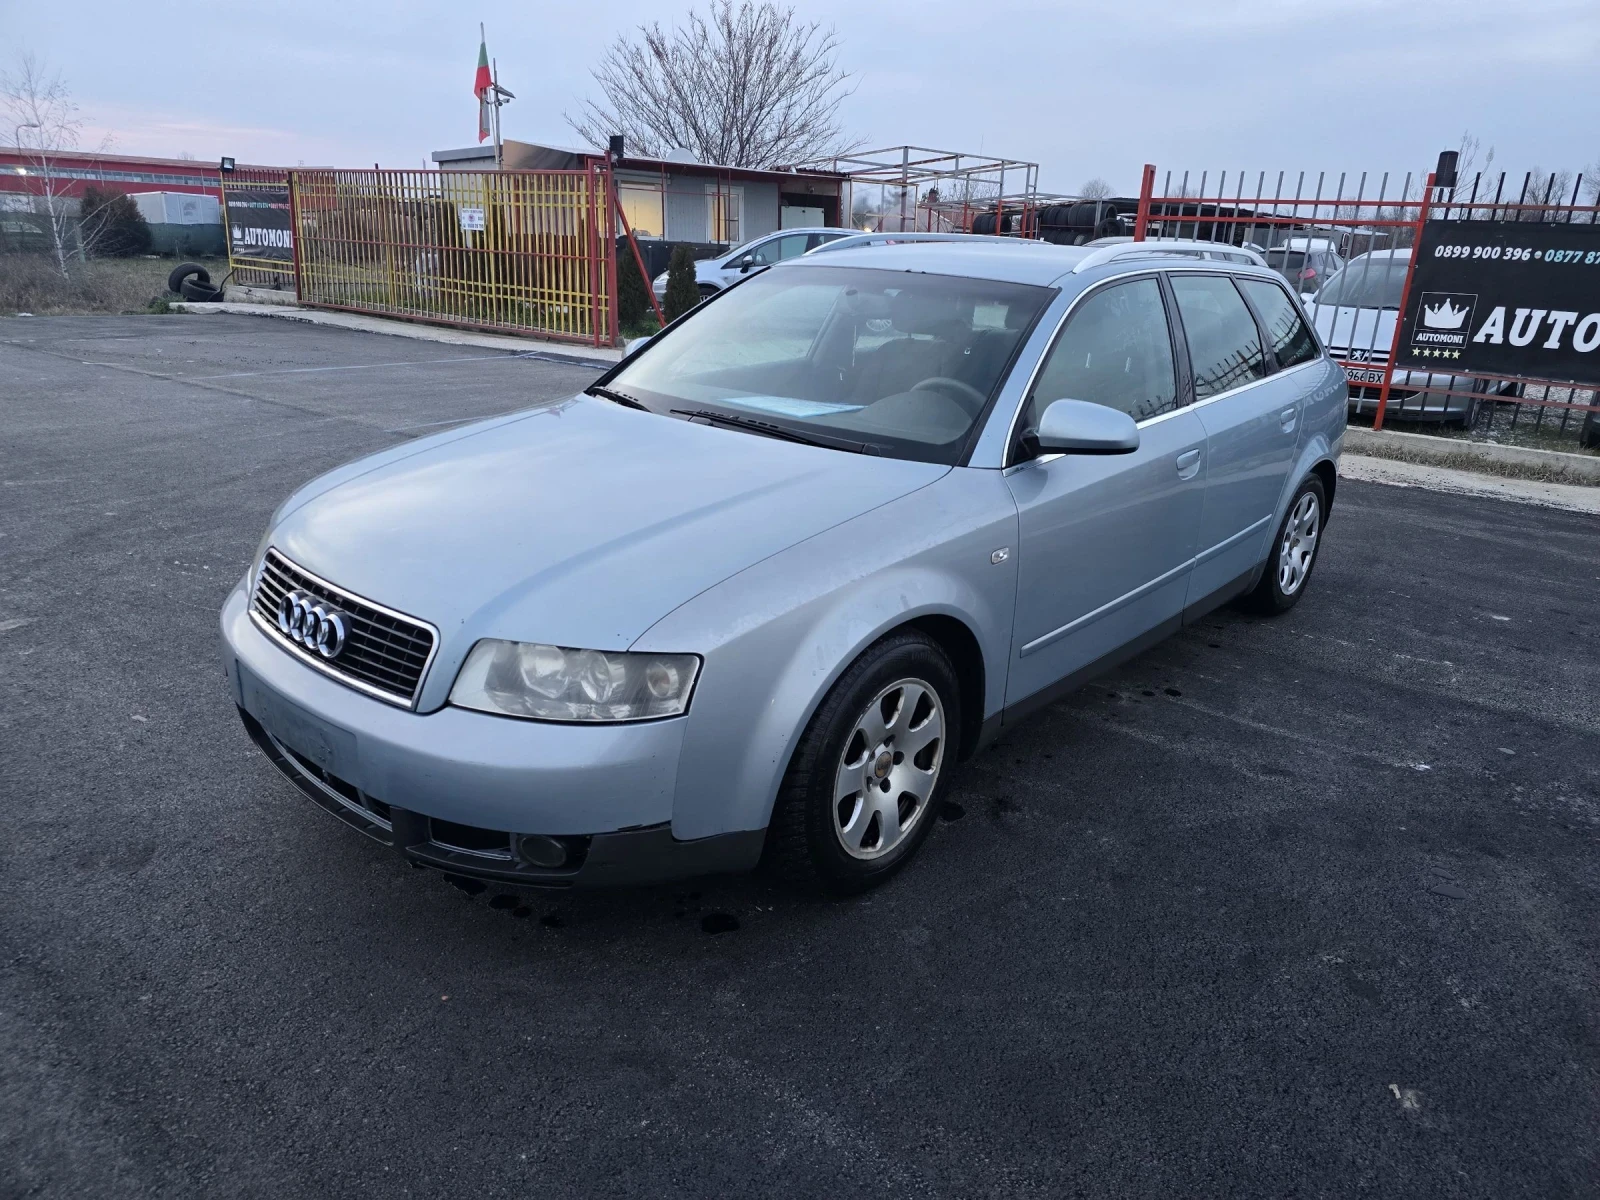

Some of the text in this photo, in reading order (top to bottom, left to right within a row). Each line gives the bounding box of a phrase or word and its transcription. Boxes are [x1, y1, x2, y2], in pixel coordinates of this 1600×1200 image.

[1434, 245, 1470, 258] 0899
[1472, 246, 1501, 259] 900
[1502, 247, 1532, 261] 396
[1544, 249, 1584, 263] 0877
[1472, 306, 1600, 353] AUTO
[1416, 332, 1464, 344] AUTOMONI
[1367, 372, 1384, 383] BX
